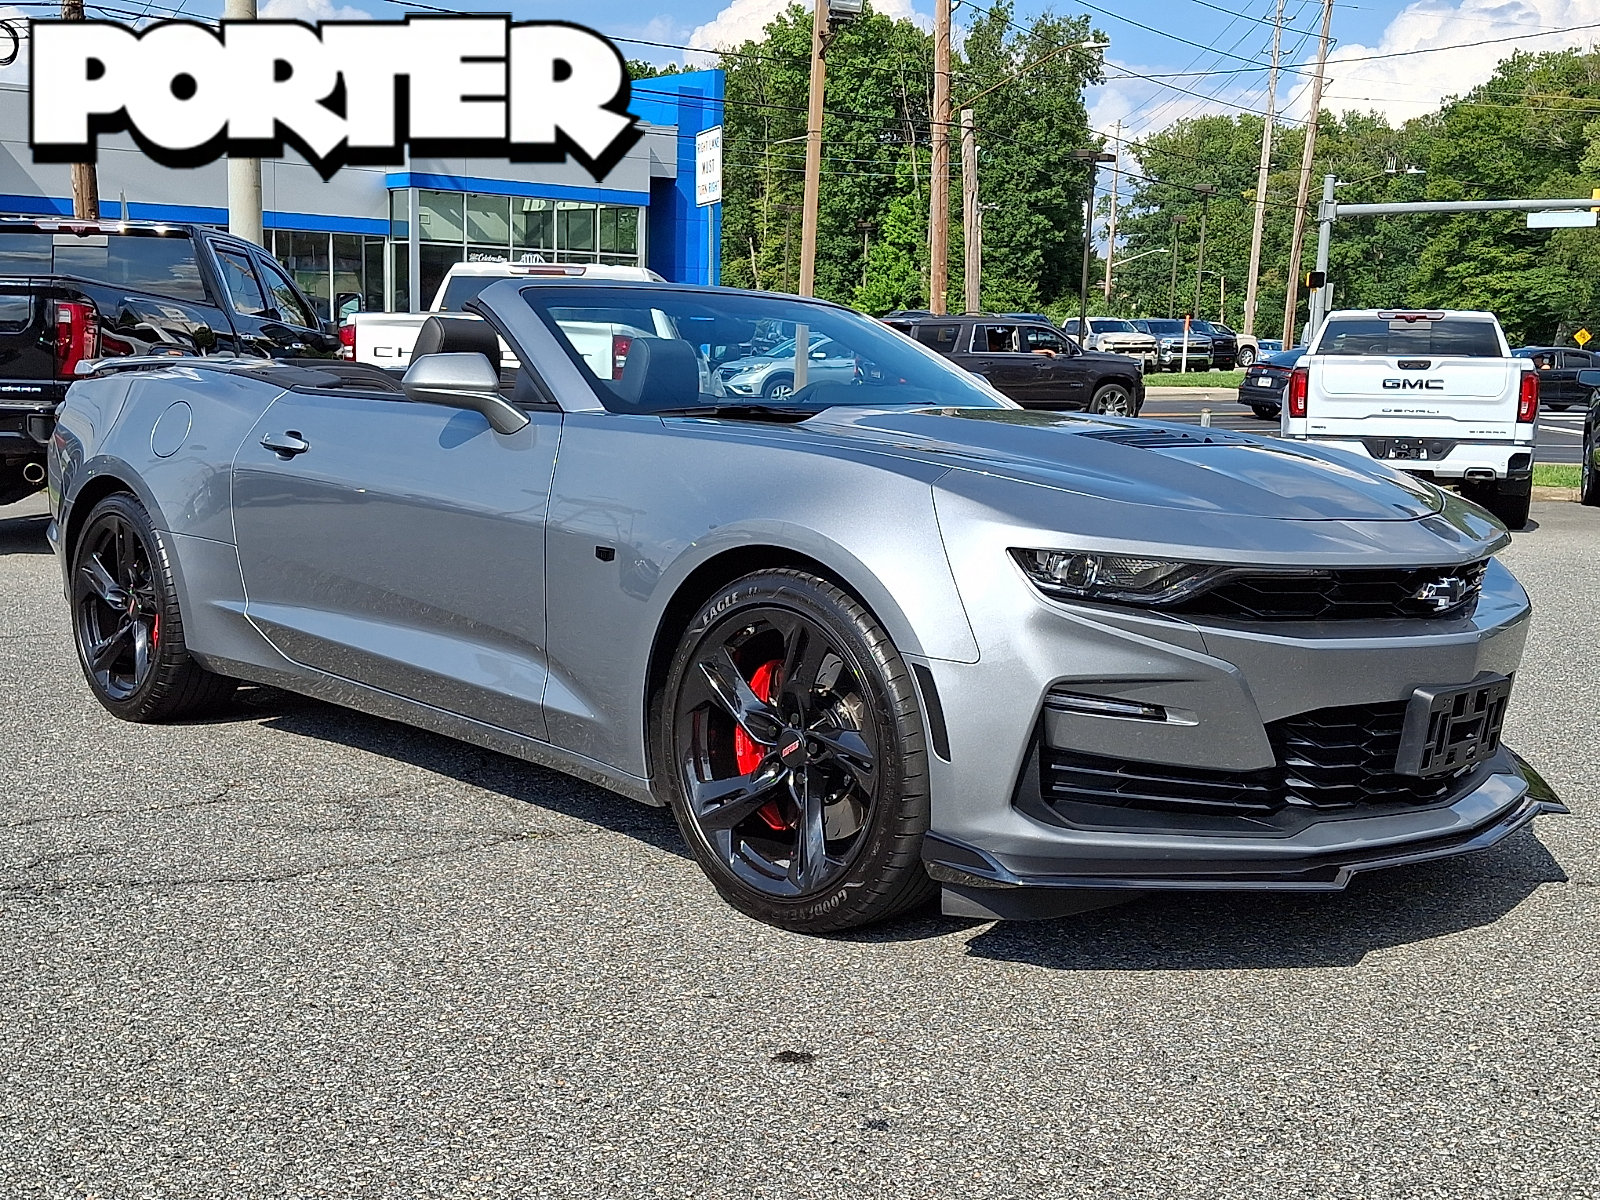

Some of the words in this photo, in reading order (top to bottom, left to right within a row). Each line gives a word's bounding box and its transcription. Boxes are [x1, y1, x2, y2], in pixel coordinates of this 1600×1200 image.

[702, 158, 715, 175] MUST
[1382, 378, 1444, 391] GMC
[702, 591, 739, 626] EAGLE
